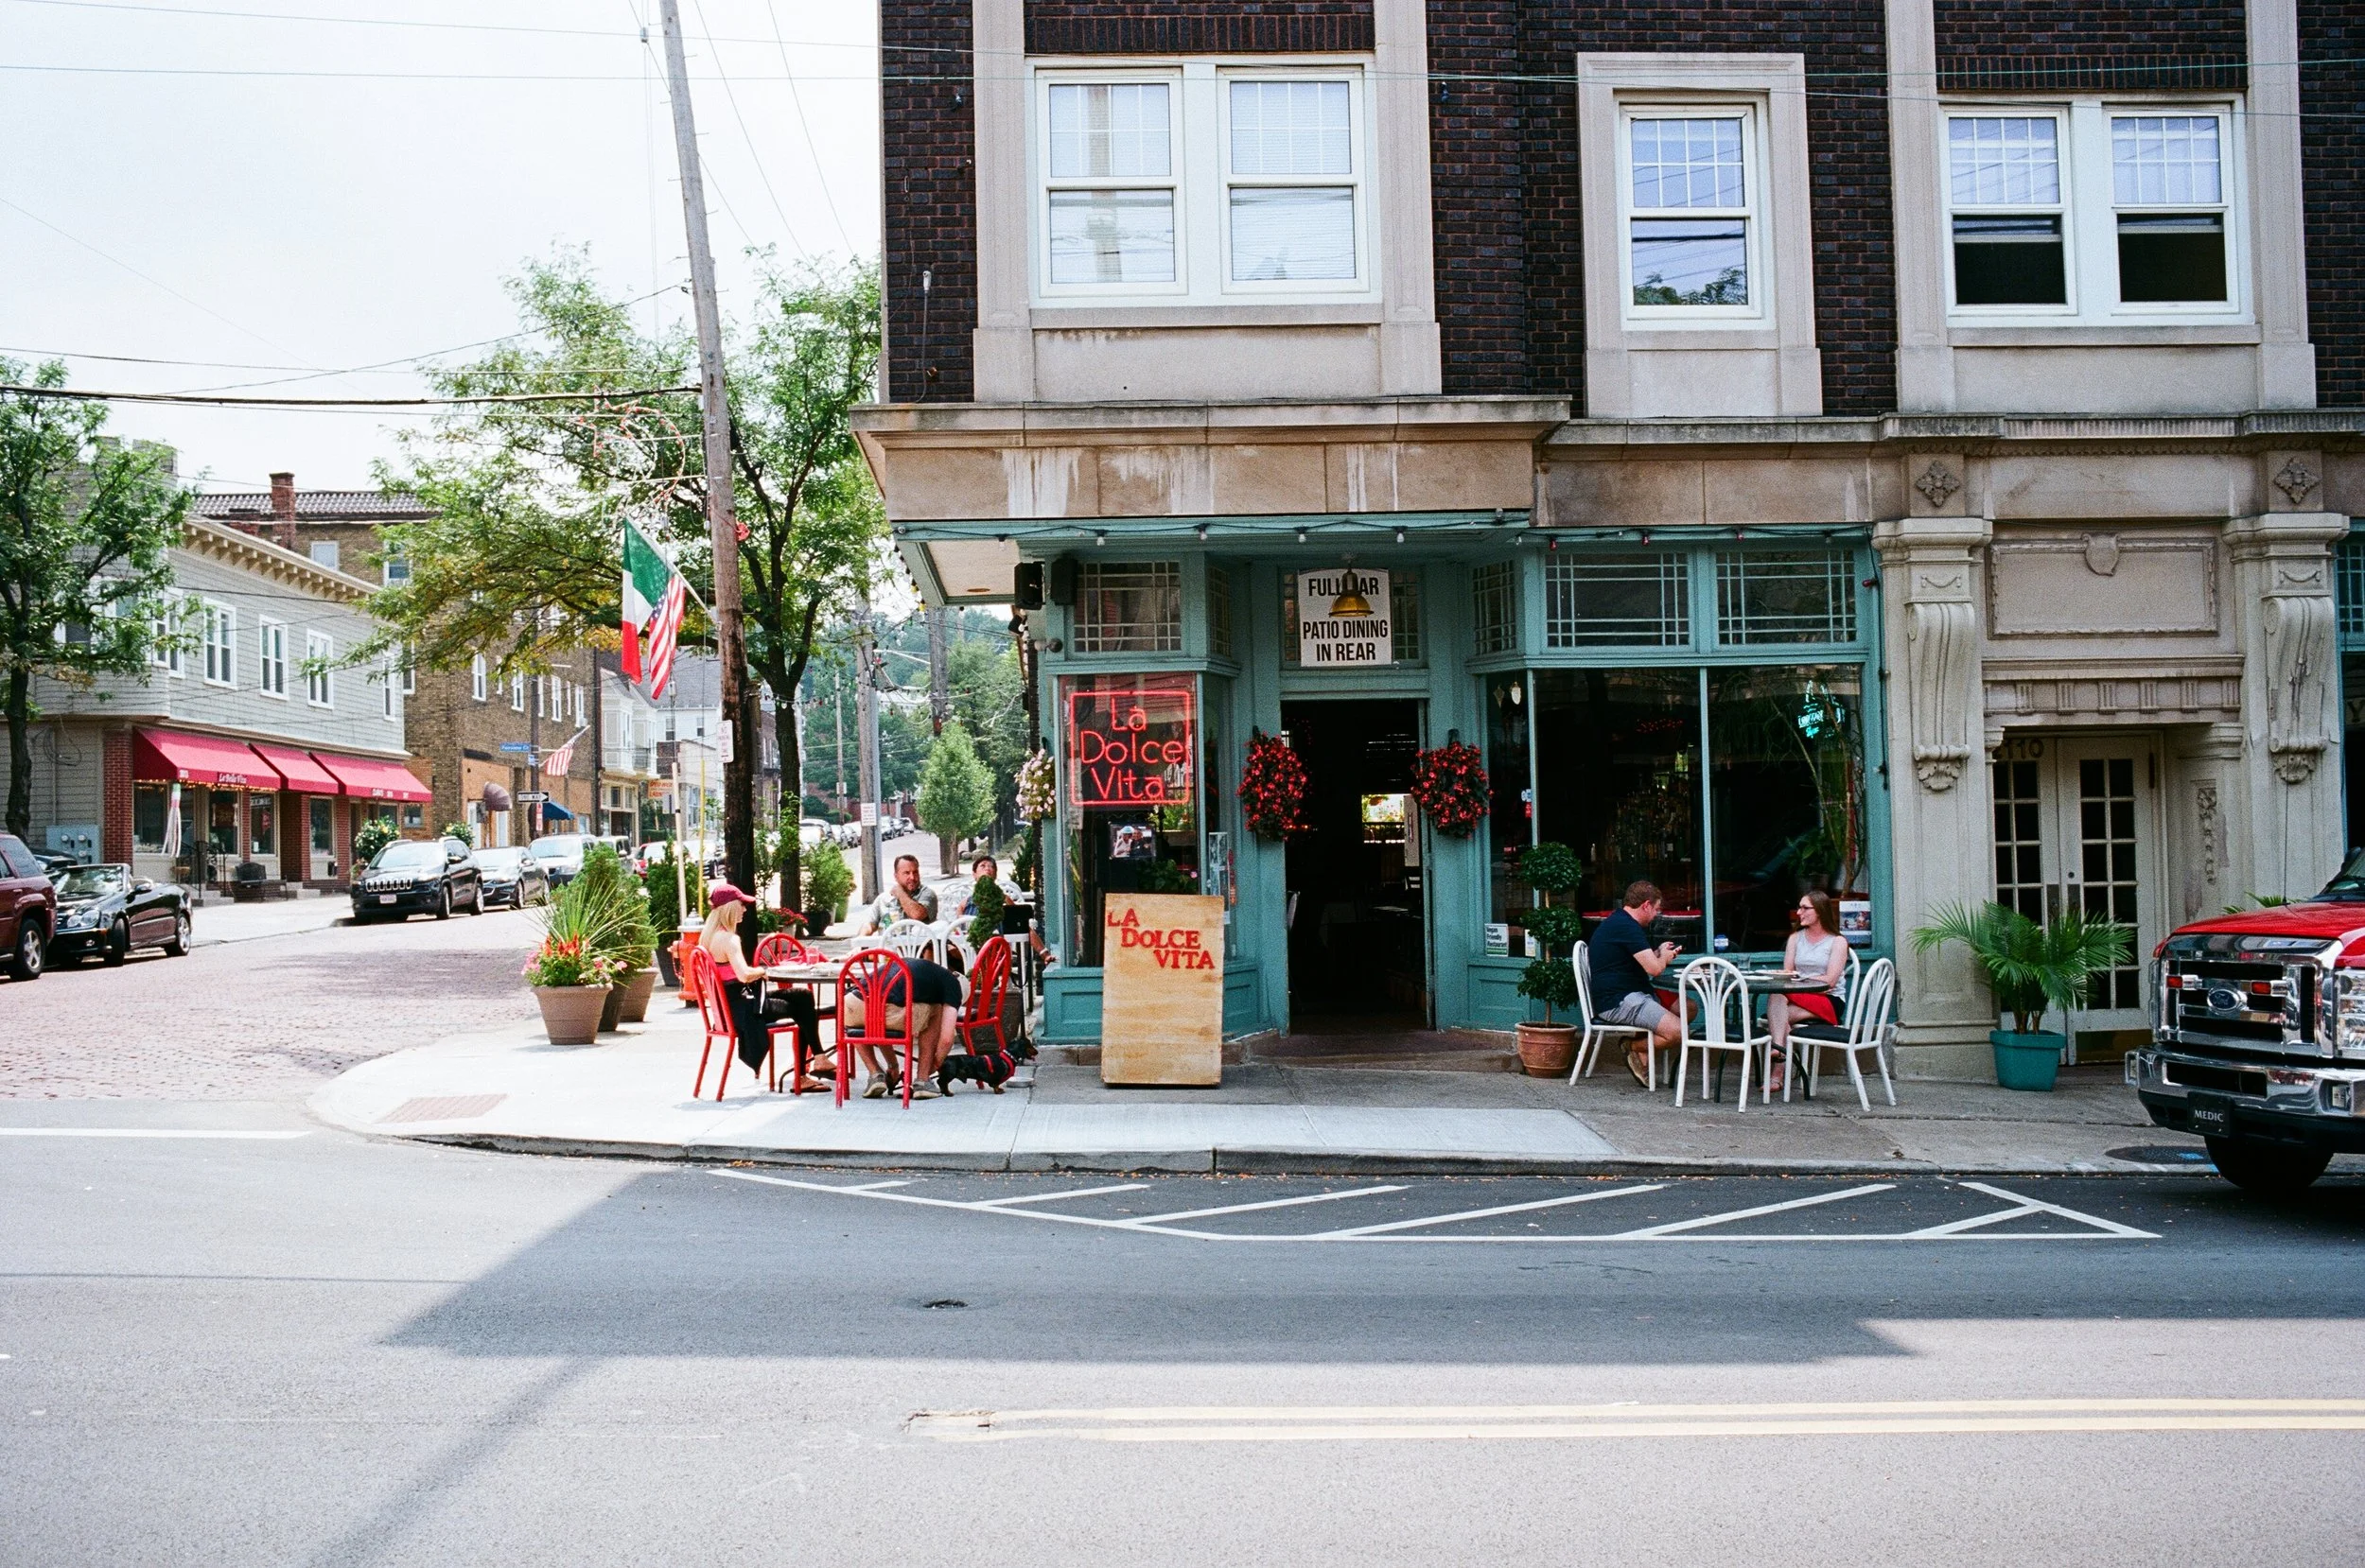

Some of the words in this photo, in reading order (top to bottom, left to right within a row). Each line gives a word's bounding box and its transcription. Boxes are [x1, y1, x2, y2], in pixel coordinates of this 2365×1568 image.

[1308, 578, 1341, 596] FULL
[1358, 577, 1379, 596] AR
[1303, 620, 1340, 639] PATIO
[1343, 619, 1388, 638] DINING
[1316, 643, 1331, 661] IN
[1336, 642, 1375, 661] REAR
[1112, 697, 1147, 731] La
[1080, 730, 1183, 764] Dolce
[1091, 766, 1165, 800] Vita
[1107, 908, 1140, 927] LA
[1121, 928, 1200, 950] DOLCE
[1153, 950, 1215, 969] VITA
[2195, 1109, 2224, 1123] MEDIC
